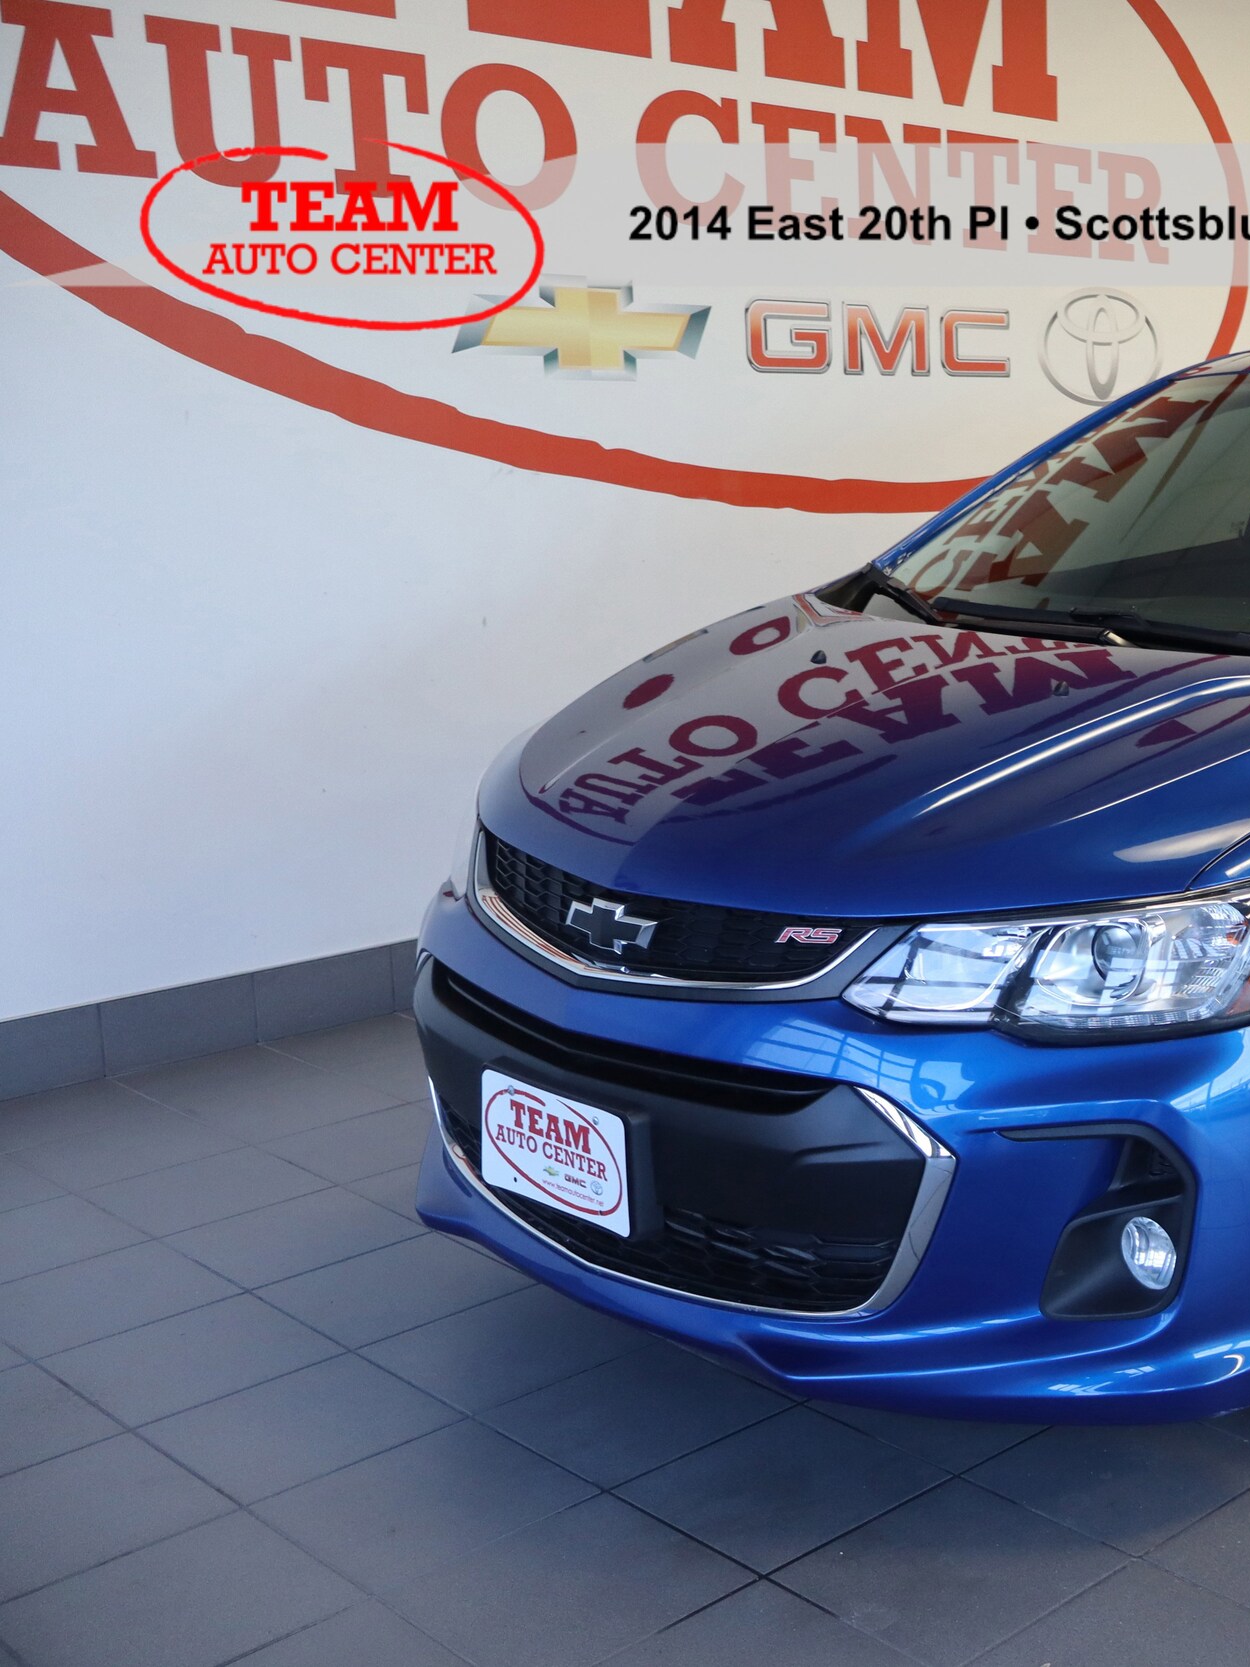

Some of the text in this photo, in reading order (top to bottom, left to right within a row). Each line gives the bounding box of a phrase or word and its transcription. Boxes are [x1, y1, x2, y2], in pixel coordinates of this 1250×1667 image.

[0, 0, 577, 210] AUTO
[635, 90, 1170, 265] CENTER
[744, 297, 1011, 377] GMC
[775, 926, 843, 944] RS
[495, 1123, 608, 1182] AUTO CENTER
[510, 1098, 592, 1155] TEAM
[564, 1173, 587, 1189] GMC
